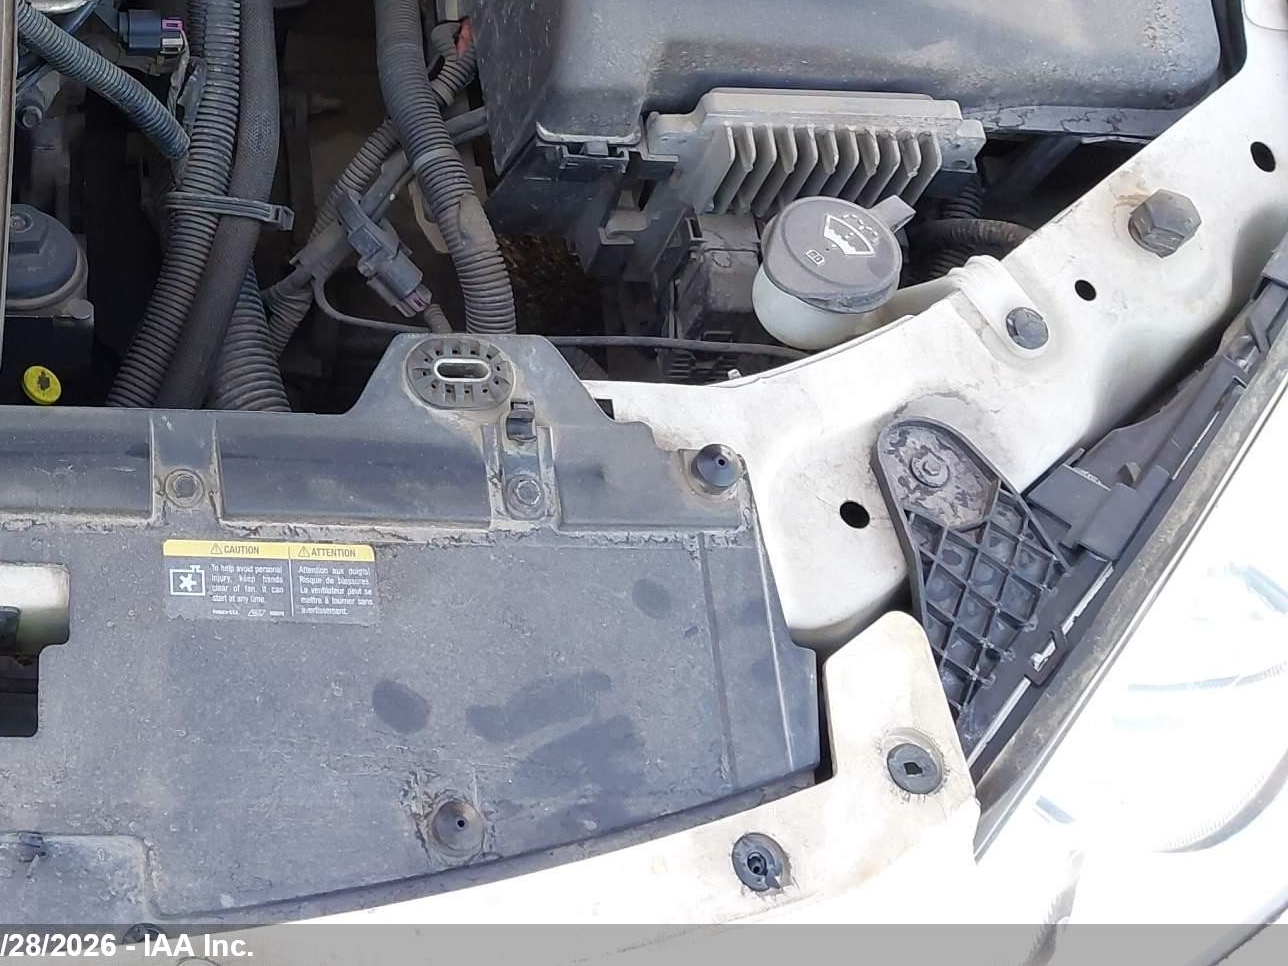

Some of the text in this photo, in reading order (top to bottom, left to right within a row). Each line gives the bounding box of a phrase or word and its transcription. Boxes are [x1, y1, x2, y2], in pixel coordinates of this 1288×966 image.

[224, 545, 259, 555] CAUTION
[312, 548, 356, 558] ATTENTION
[220, 564, 235, 573] help
[236, 565, 254, 573] avoid
[255, 565, 283, 574] personal
[298, 565, 329, 574] Attention
[299, 575, 322, 584] Risque
[325, 576, 335, 584] de
[300, 586, 308, 594] Le
[311, 586, 345, 594] ventilateur
[347, 587, 362, 596] peut
[237, 596, 249, 604] any
